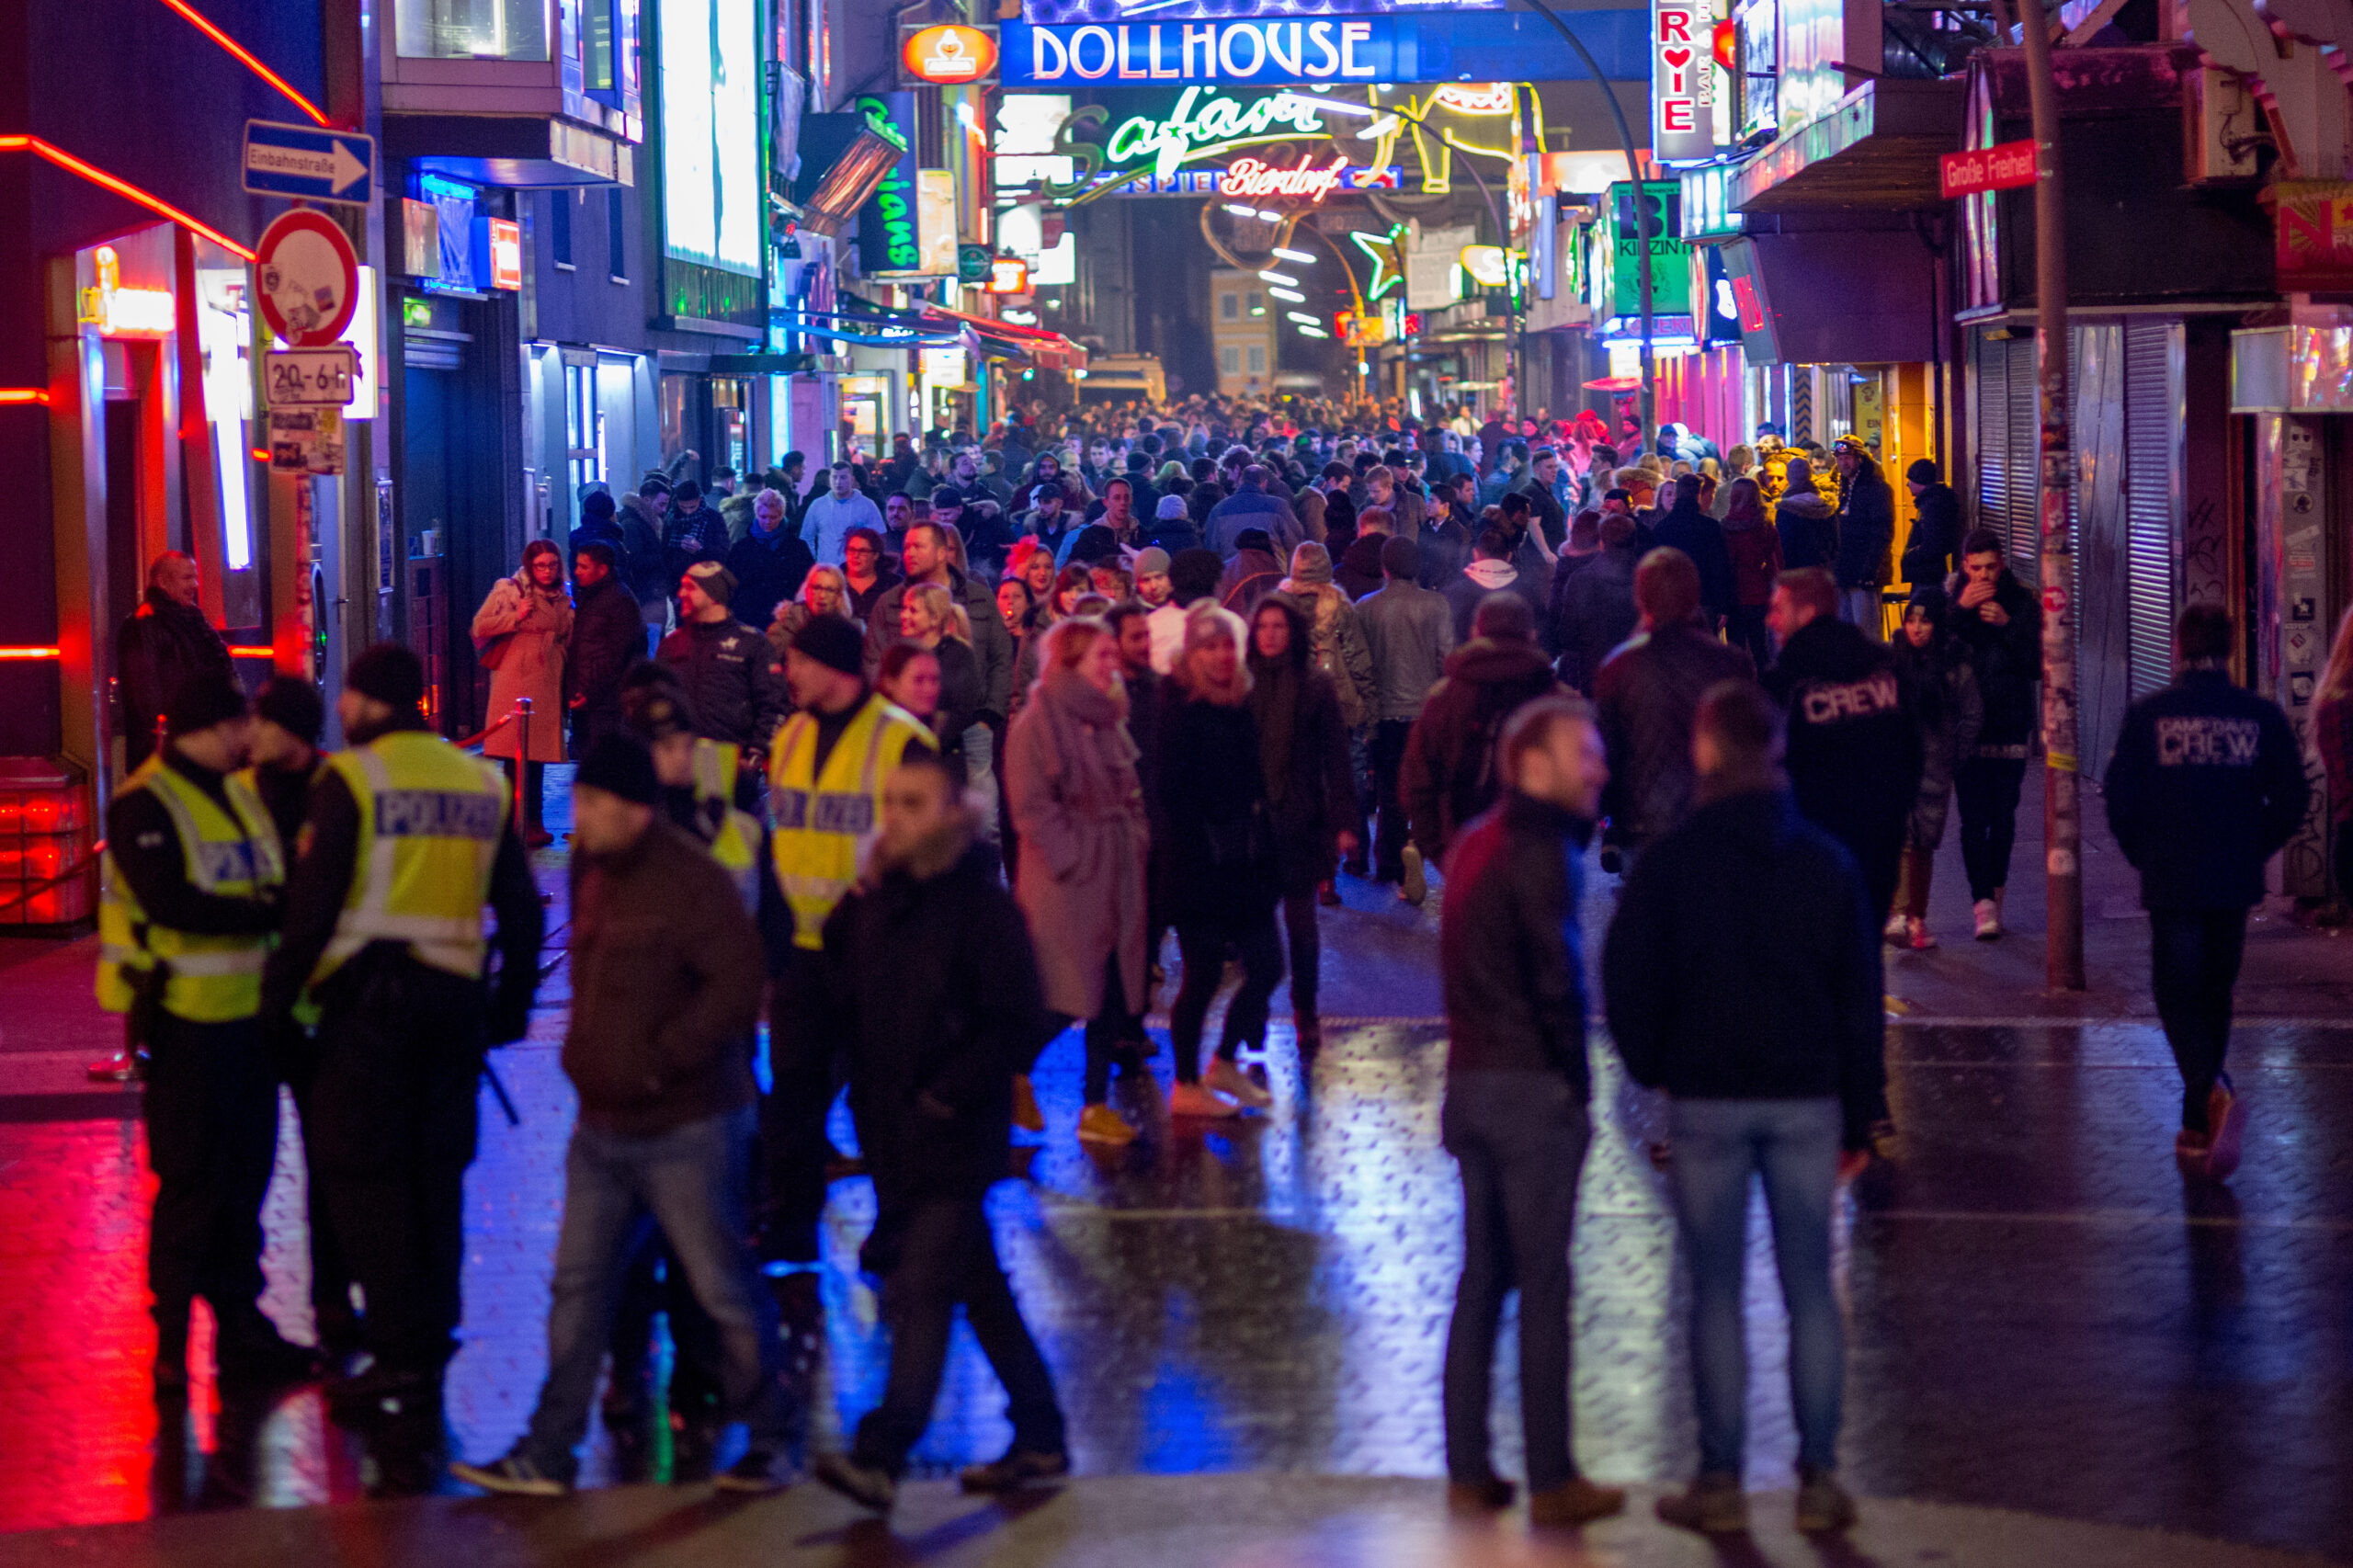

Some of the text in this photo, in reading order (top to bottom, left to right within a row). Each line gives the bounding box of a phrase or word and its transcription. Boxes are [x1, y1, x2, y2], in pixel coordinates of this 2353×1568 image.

[1032, 22, 1376, 80] DOLLHOUSE
[1697, 55, 1712, 108] BAR
[249, 147, 335, 175] Einbahnstraße
[1220, 153, 1349, 203] Bierdorf
[1947, 147, 2034, 187] Große Freiheit
[1803, 679, 1899, 723] CREW
[2158, 734, 2259, 757] CREW
